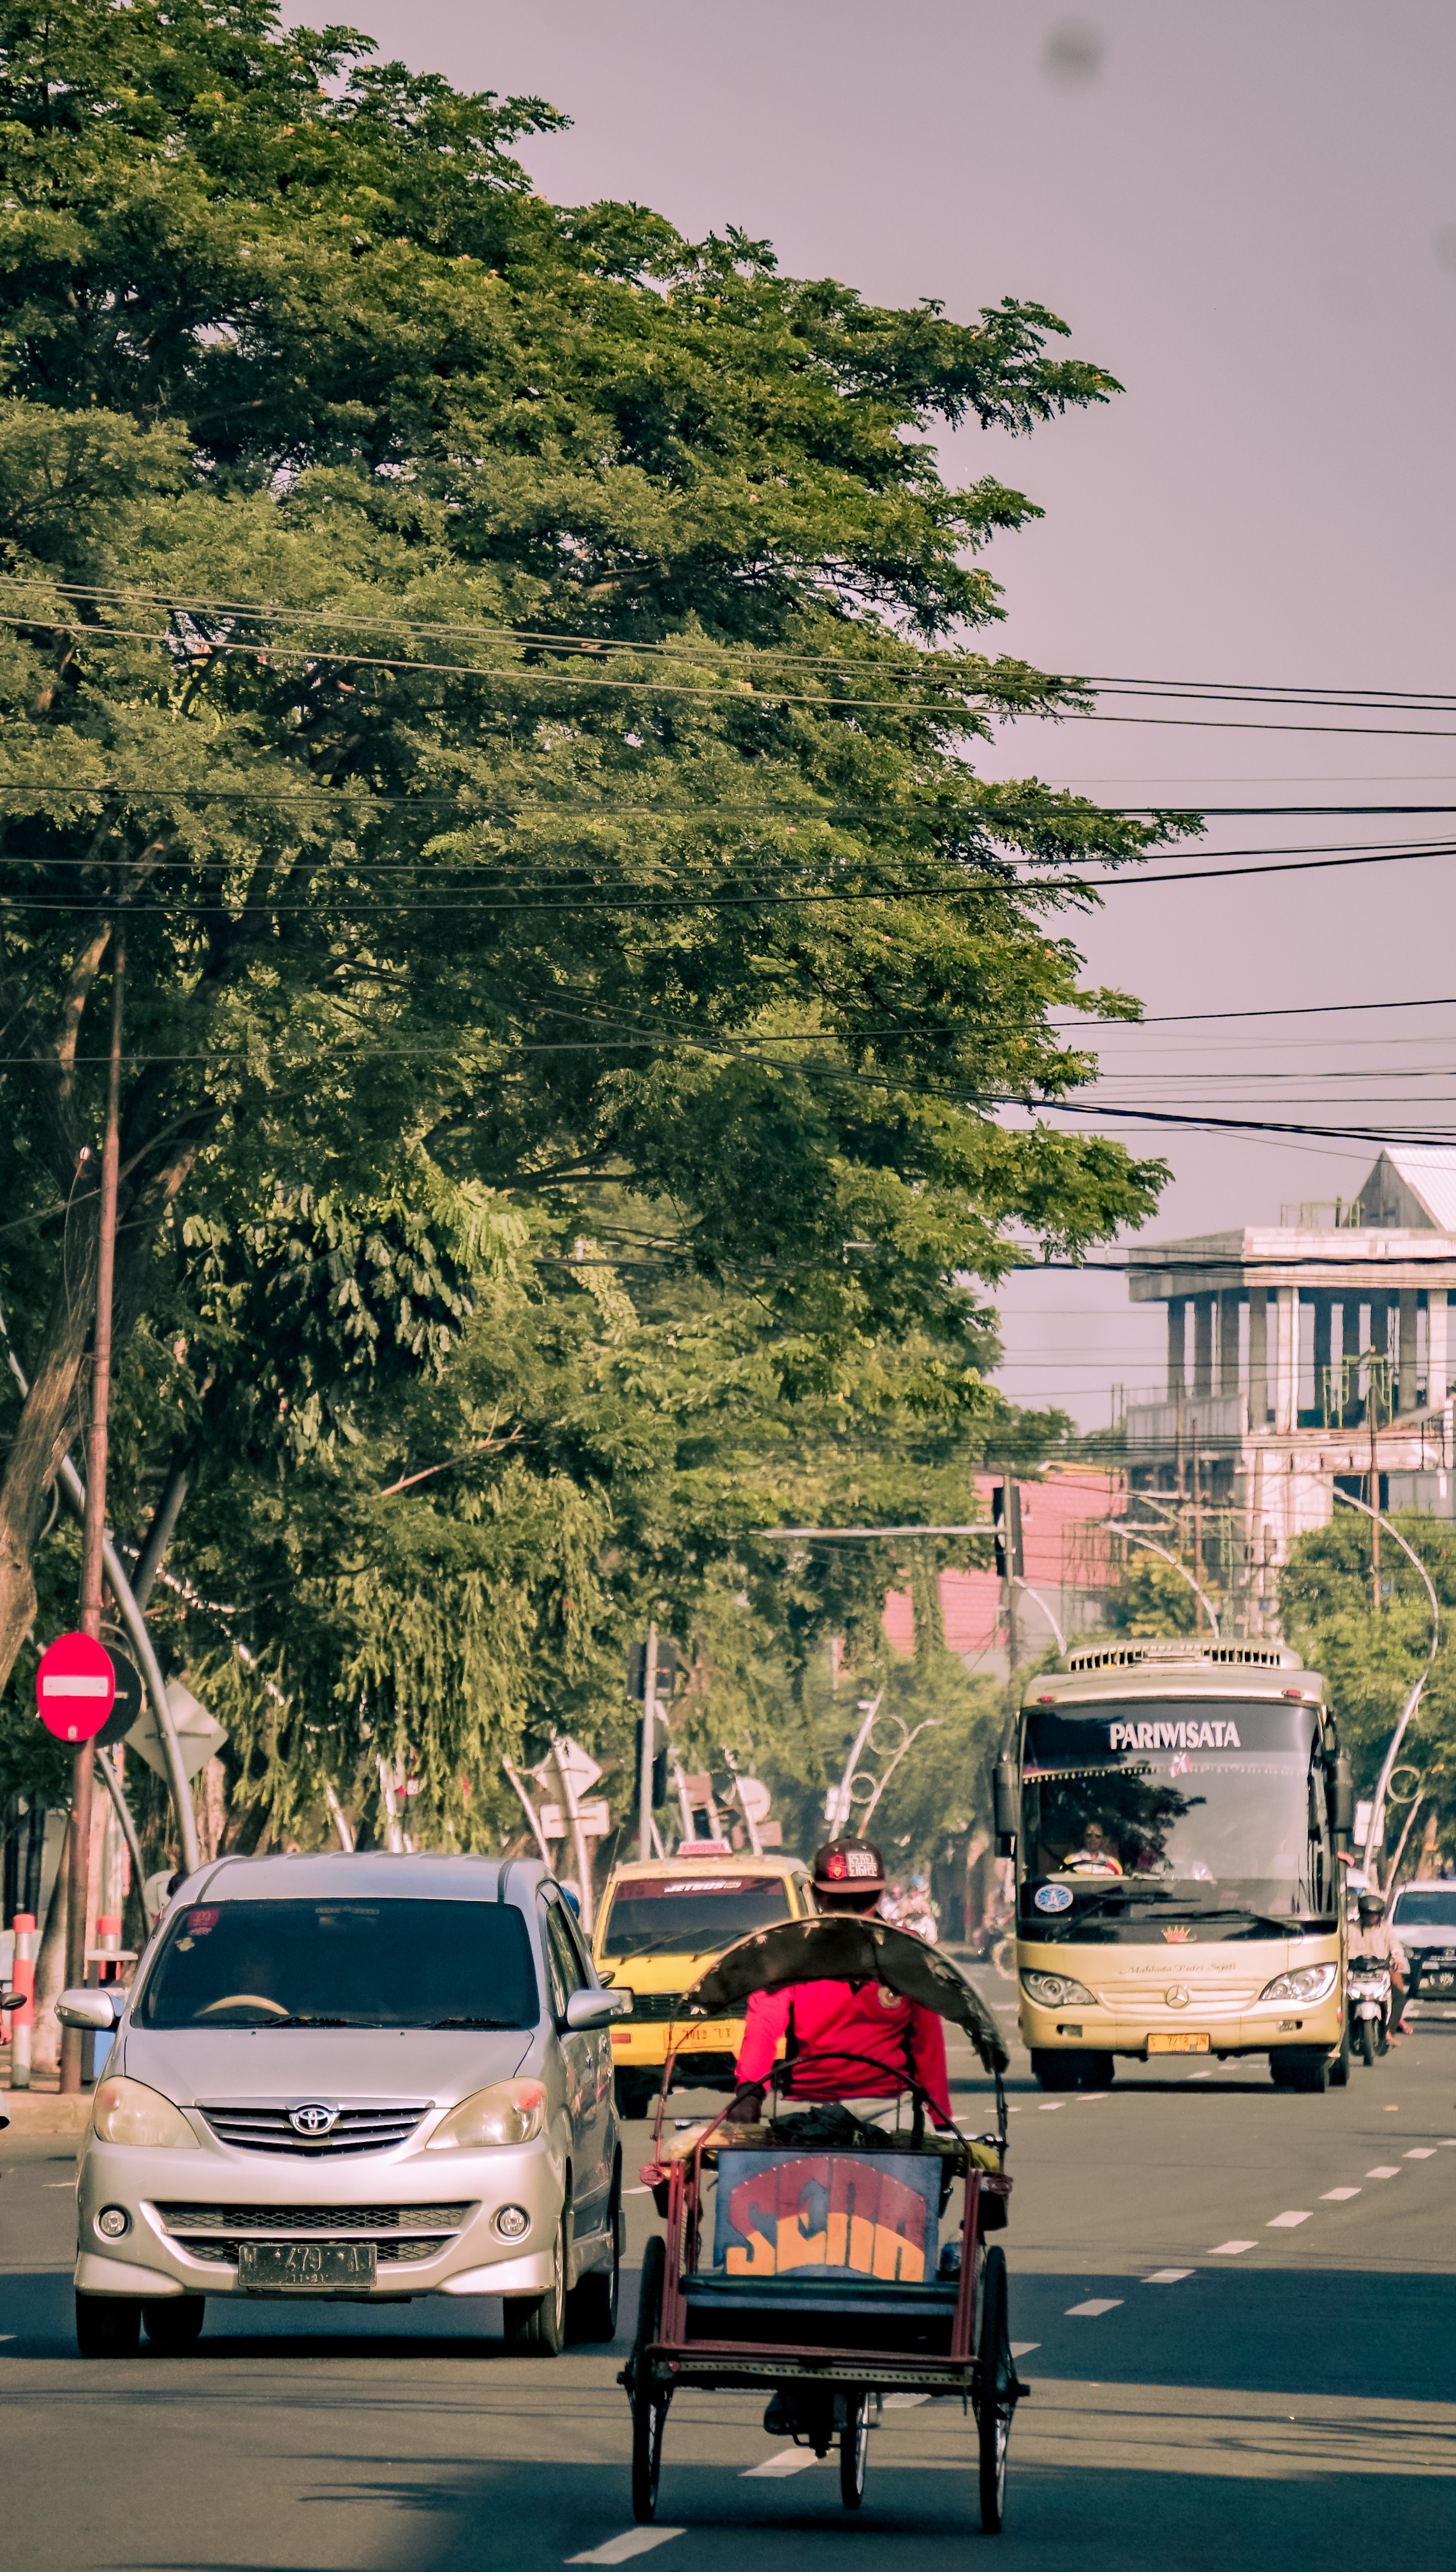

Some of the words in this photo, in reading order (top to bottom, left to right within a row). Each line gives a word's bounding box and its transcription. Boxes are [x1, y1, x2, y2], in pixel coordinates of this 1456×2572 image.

[1110, 1721, 1241, 1750] PARIWISATA
[682, 1843, 725, 1853] ANGGUNA
[848, 1864, 878, 1877] EIGHT
[1119, 1964, 1172, 1975] Mahkota
